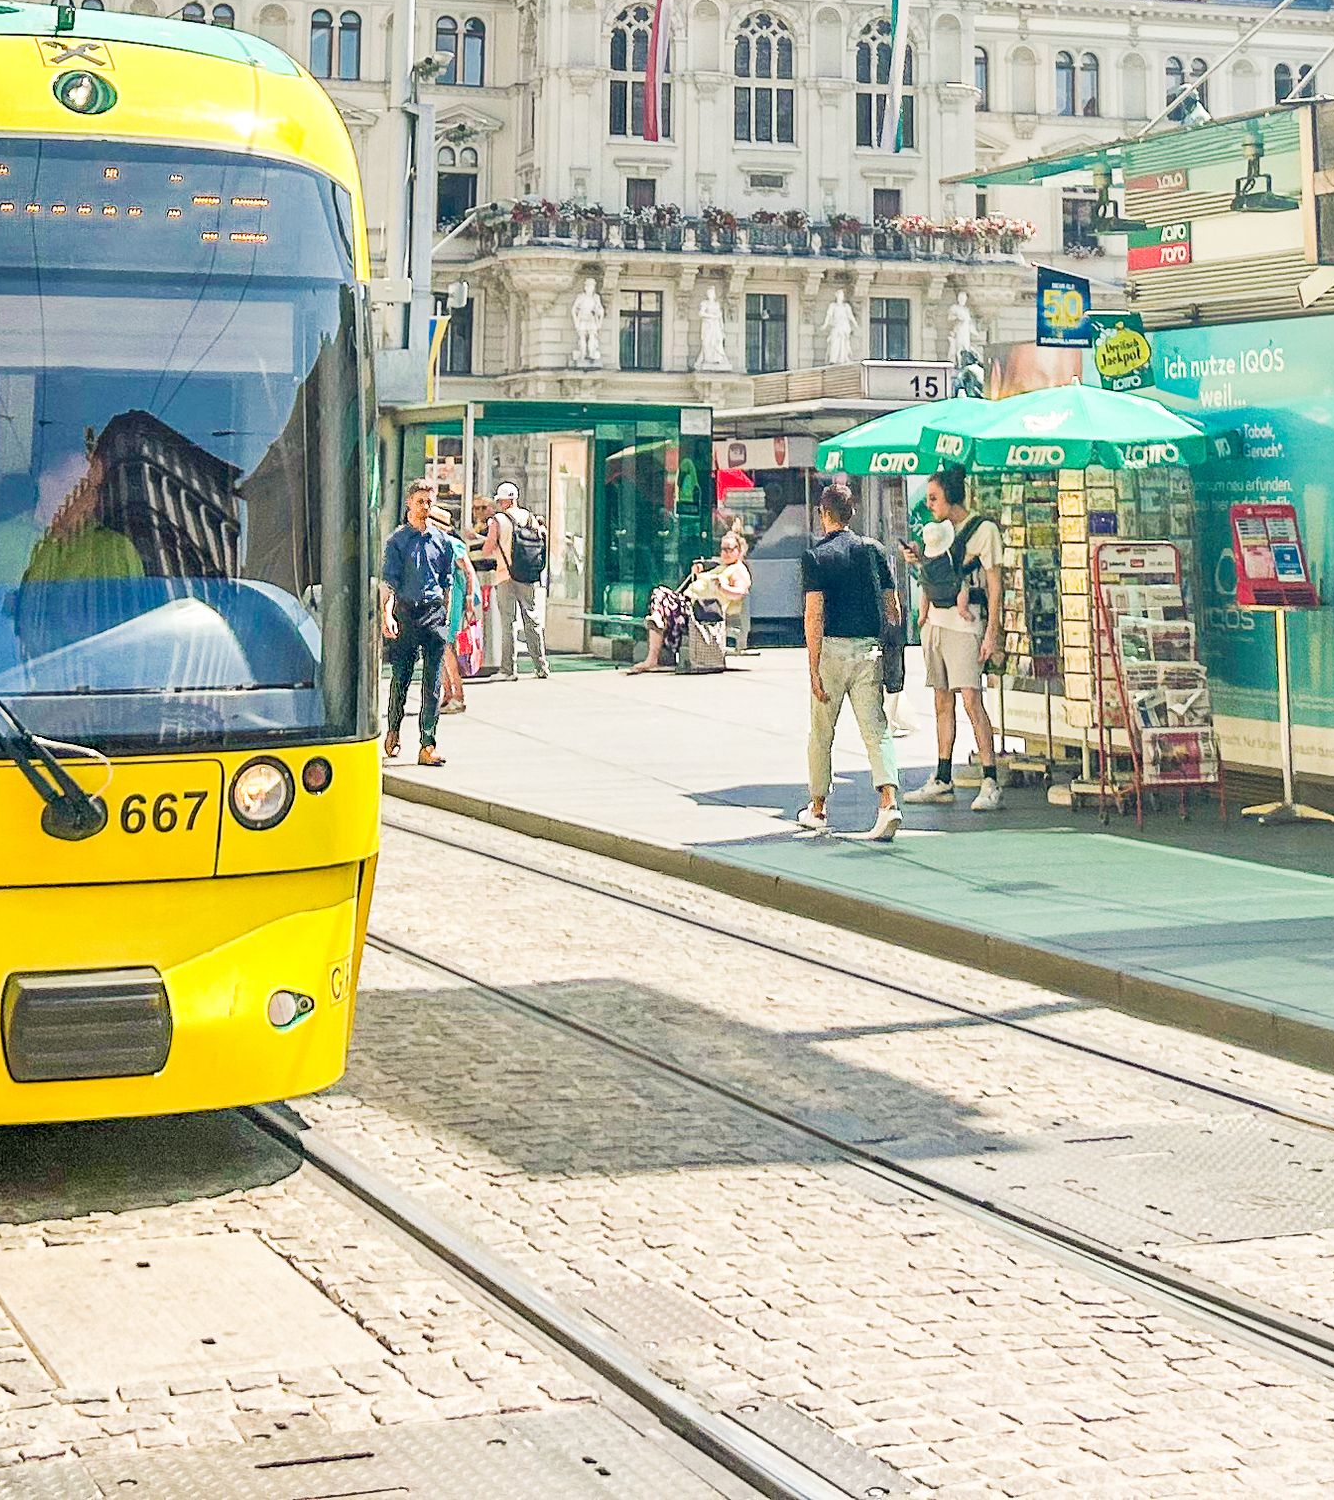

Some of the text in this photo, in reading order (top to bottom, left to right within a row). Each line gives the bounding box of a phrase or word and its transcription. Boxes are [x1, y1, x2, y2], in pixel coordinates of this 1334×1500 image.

[1043, 289, 1083, 319] 50
[1102, 348, 1141, 367] Jackpot
[1164, 348, 1285, 379] Ich nutze IQOS
[910, 376, 938, 399] 15
[1112, 375, 1142, 391] LOTTO
[1200, 382, 1247, 408] weil...
[935, 432, 963, 457] LOTTO
[1006, 445, 1065, 466] LOTTO
[869, 452, 919, 472] LOTTO
[1245, 476, 1293, 492] erfunden.
[120, 791, 208, 833] 667
